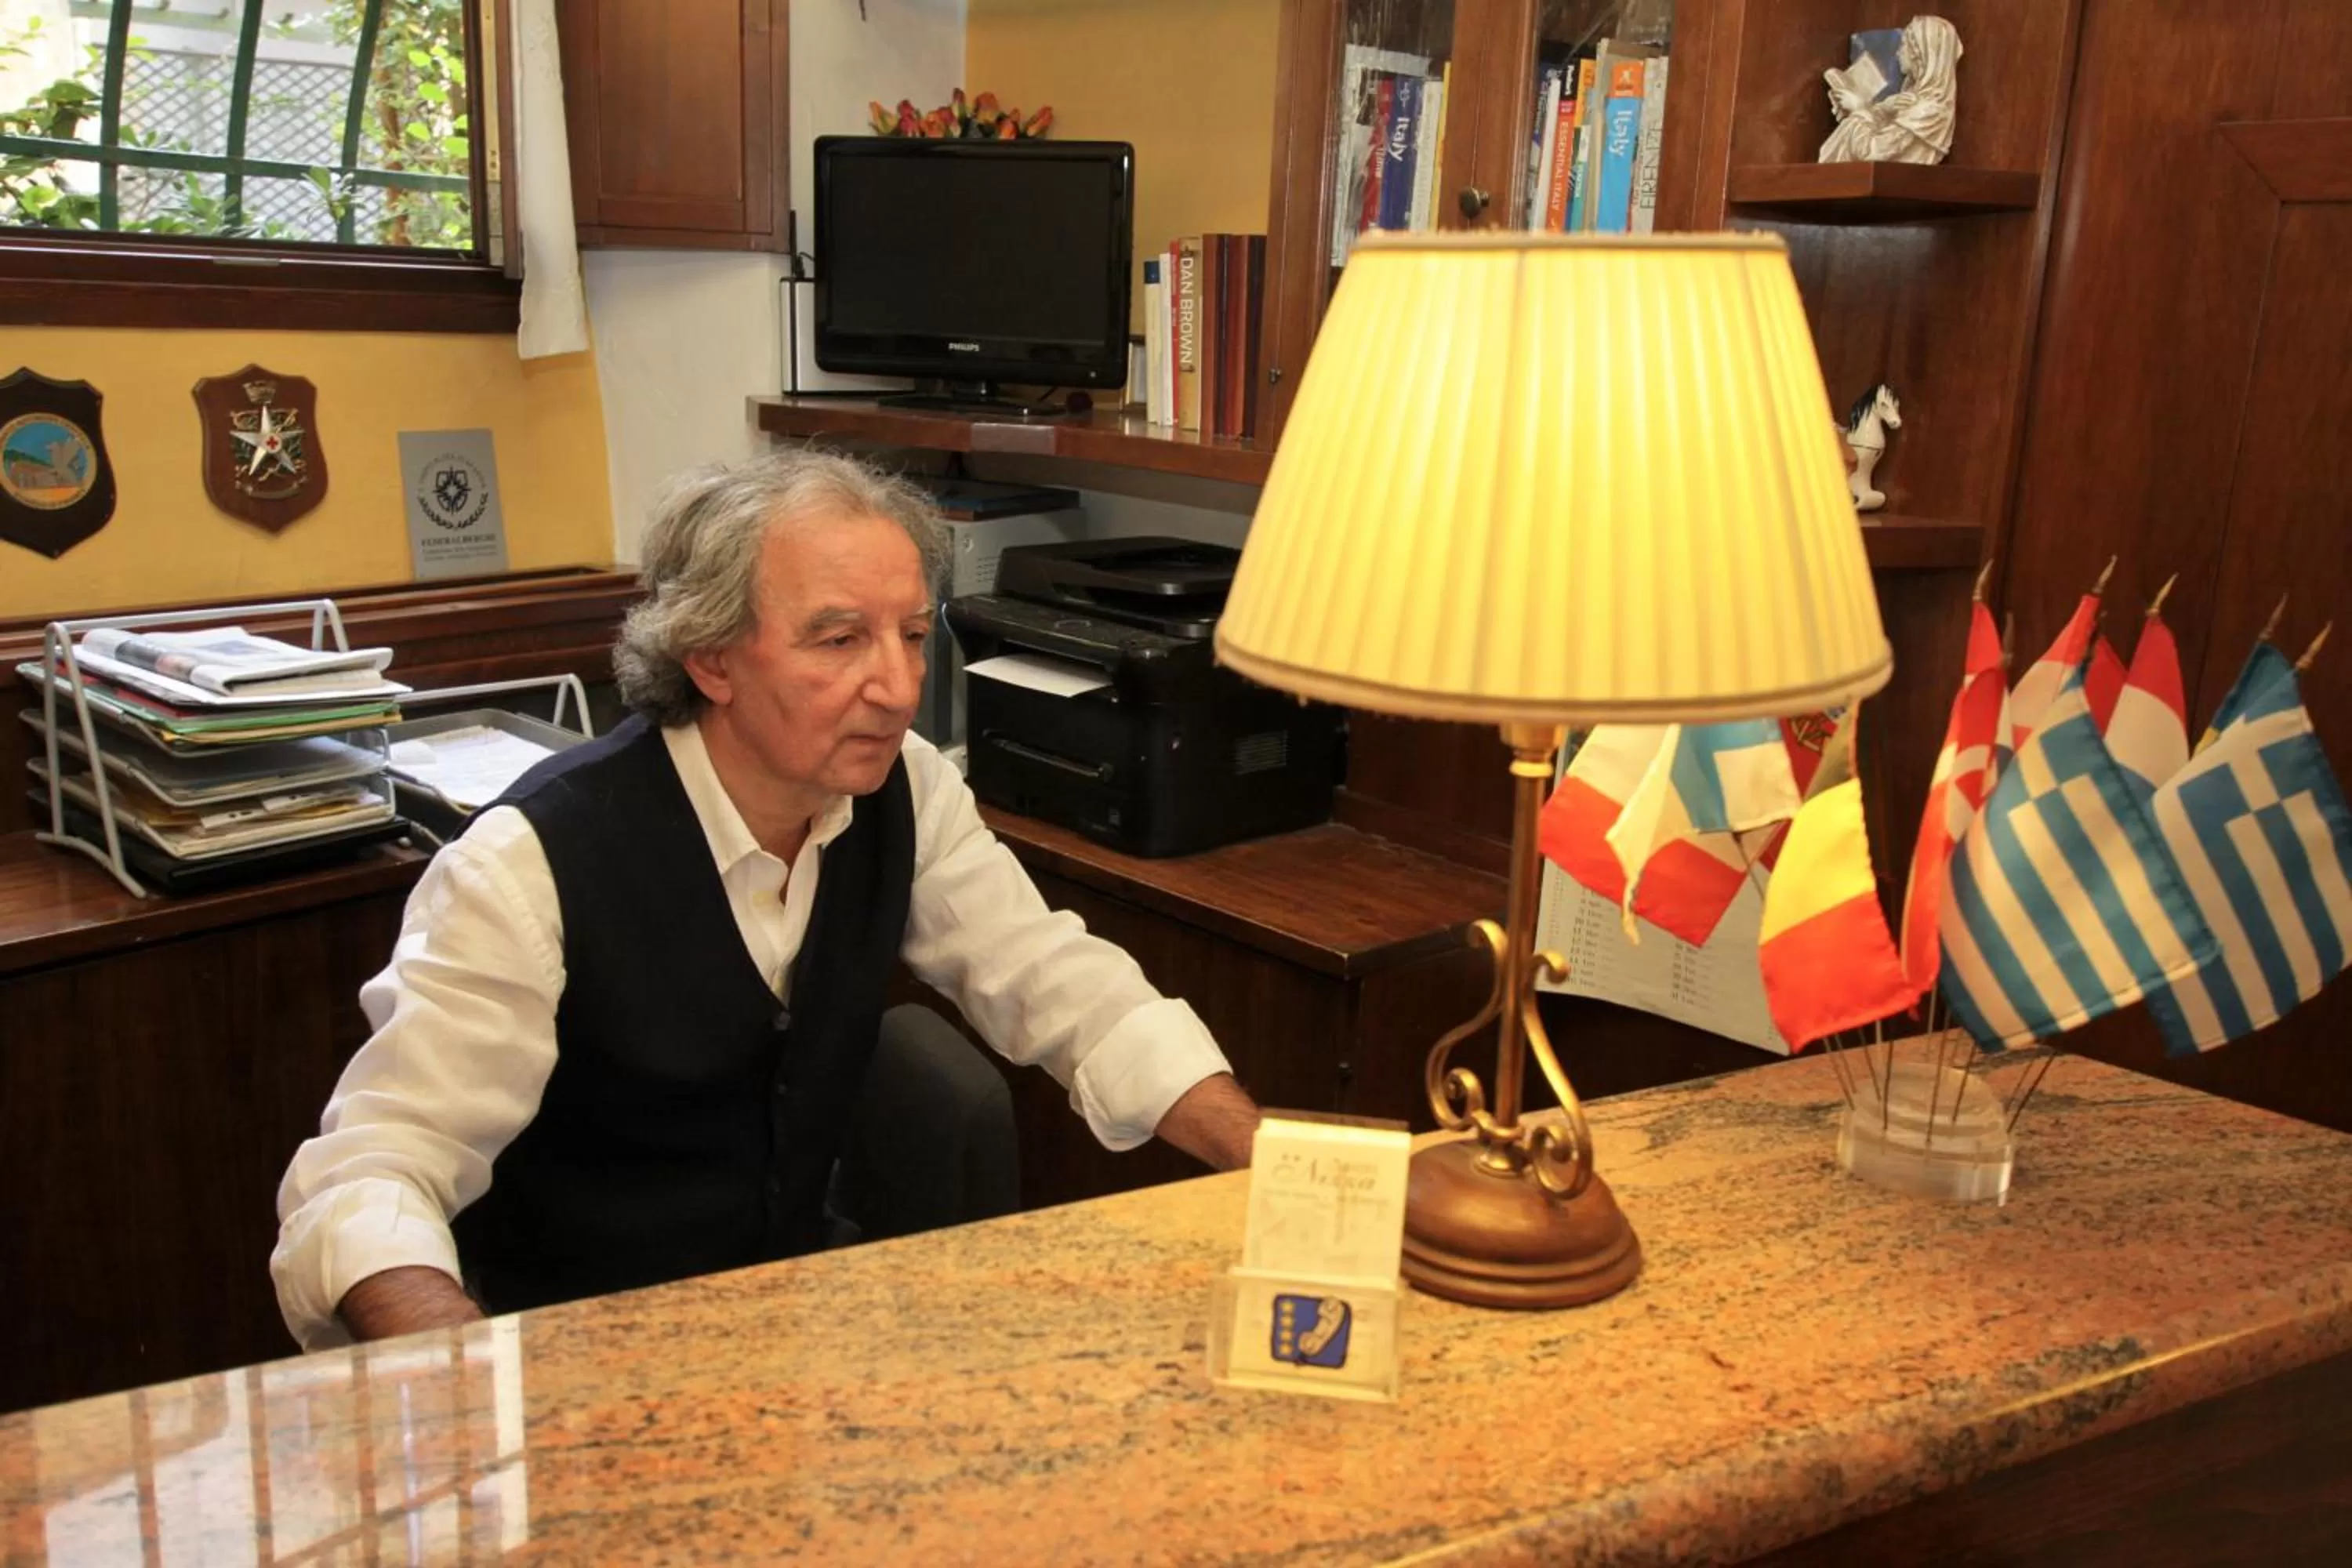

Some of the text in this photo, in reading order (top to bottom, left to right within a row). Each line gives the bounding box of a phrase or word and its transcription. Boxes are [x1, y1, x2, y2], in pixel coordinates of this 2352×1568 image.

[1388, 117, 1410, 162] Italy
[1553, 121, 1568, 180] ESSENTIAL
[1609, 110, 1633, 158] Italy
[1179, 257, 1193, 364] DAN BROWN
